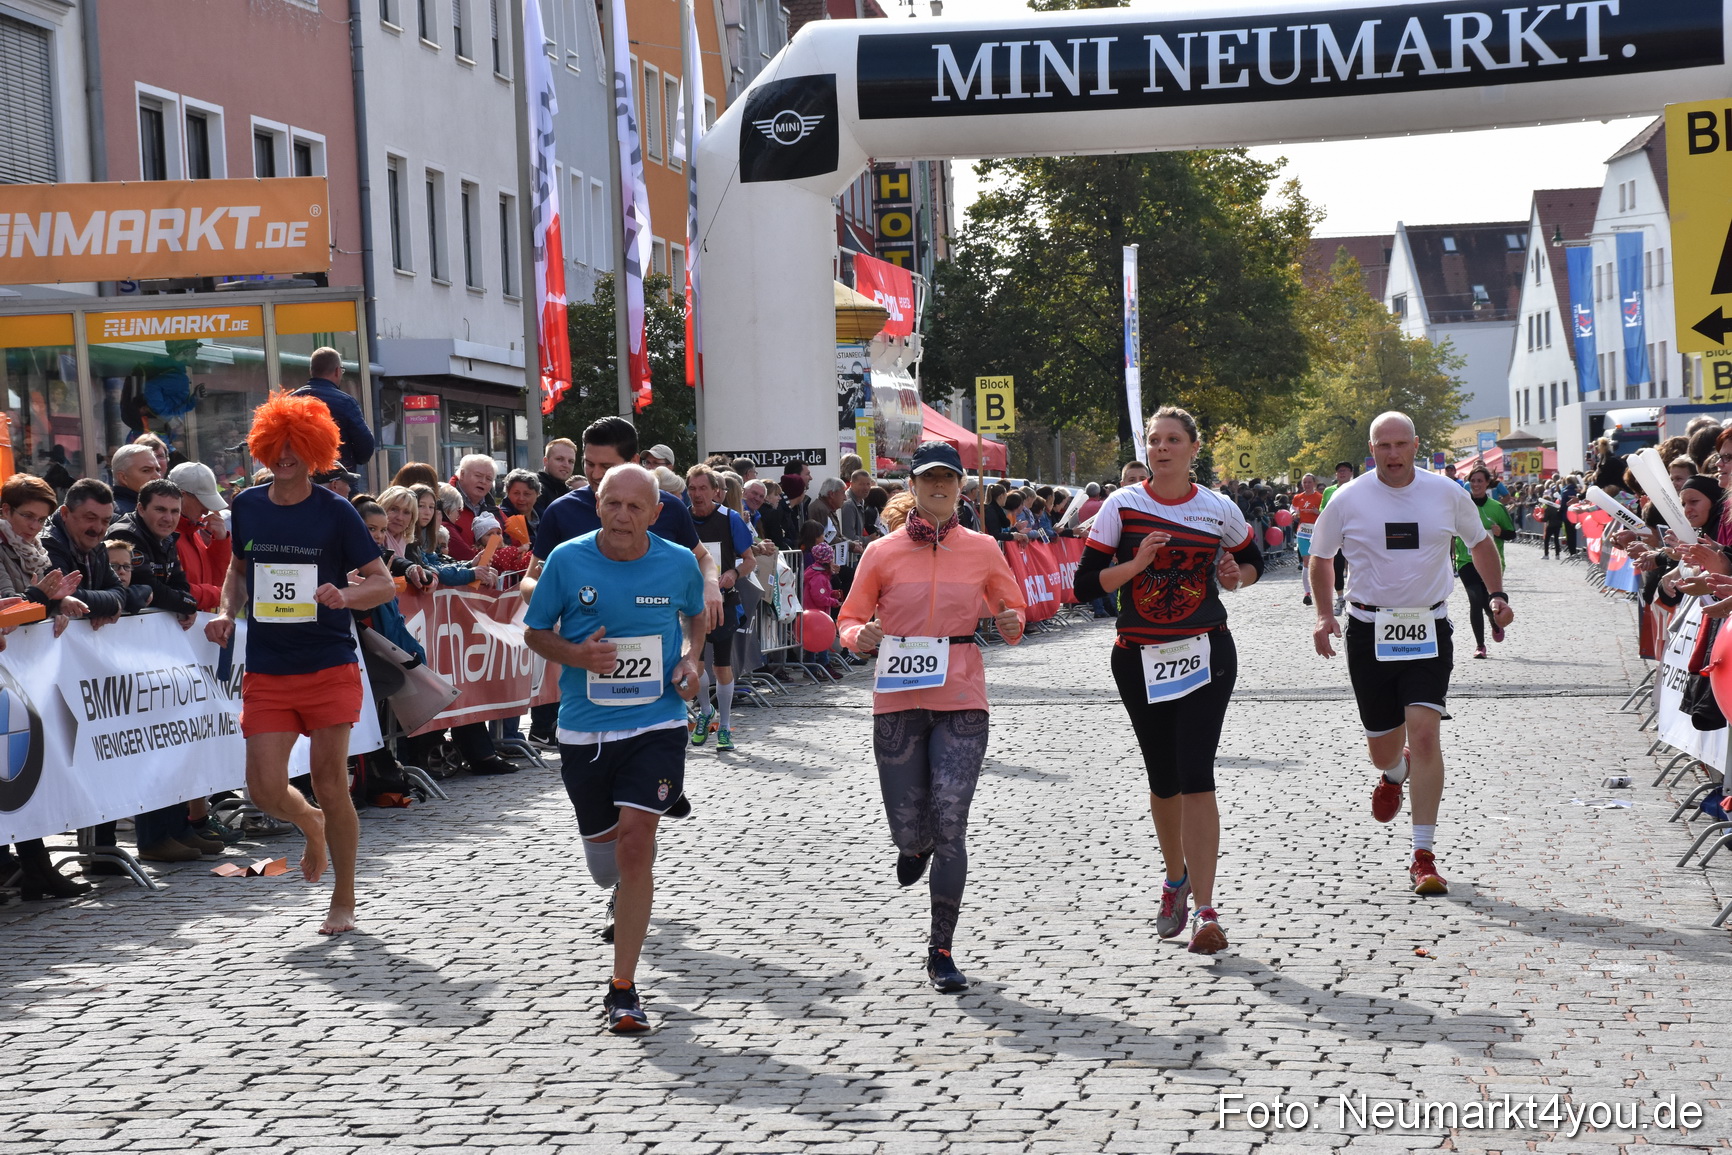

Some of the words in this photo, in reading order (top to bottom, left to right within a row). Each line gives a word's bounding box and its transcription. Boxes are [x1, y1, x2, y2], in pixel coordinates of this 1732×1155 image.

[931, 37, 1118, 102] MINI
[1143, 1, 1637, 93] NEUMARKT.
[775, 122, 801, 134] MINI
[104, 314, 249, 337] RUNMARKT.DE
[1713, 361, 1732, 390] B
[980, 378, 1009, 390] Block
[986, 393, 1005, 421] B
[1239, 452, 1250, 468] C
[1531, 457, 1540, 469] D
[1293, 468, 1302, 480] D
[1184, 515, 1219, 525] NEUMARKT
[253, 543, 279, 552] GOSSEN
[280, 544, 323, 556] METRAWATT
[273, 582, 296, 600] 35
[636, 596, 670, 605] BOCK
[1384, 624, 1427, 641] 2048
[1392, 646, 1421, 654] Wolfgang
[887, 655, 938, 674] 2039
[1154, 655, 1201, 680] 2726
[79, 673, 132, 721] BMW
[612, 686, 640, 695] Ludwig
[91, 727, 146, 762] WENIGER
